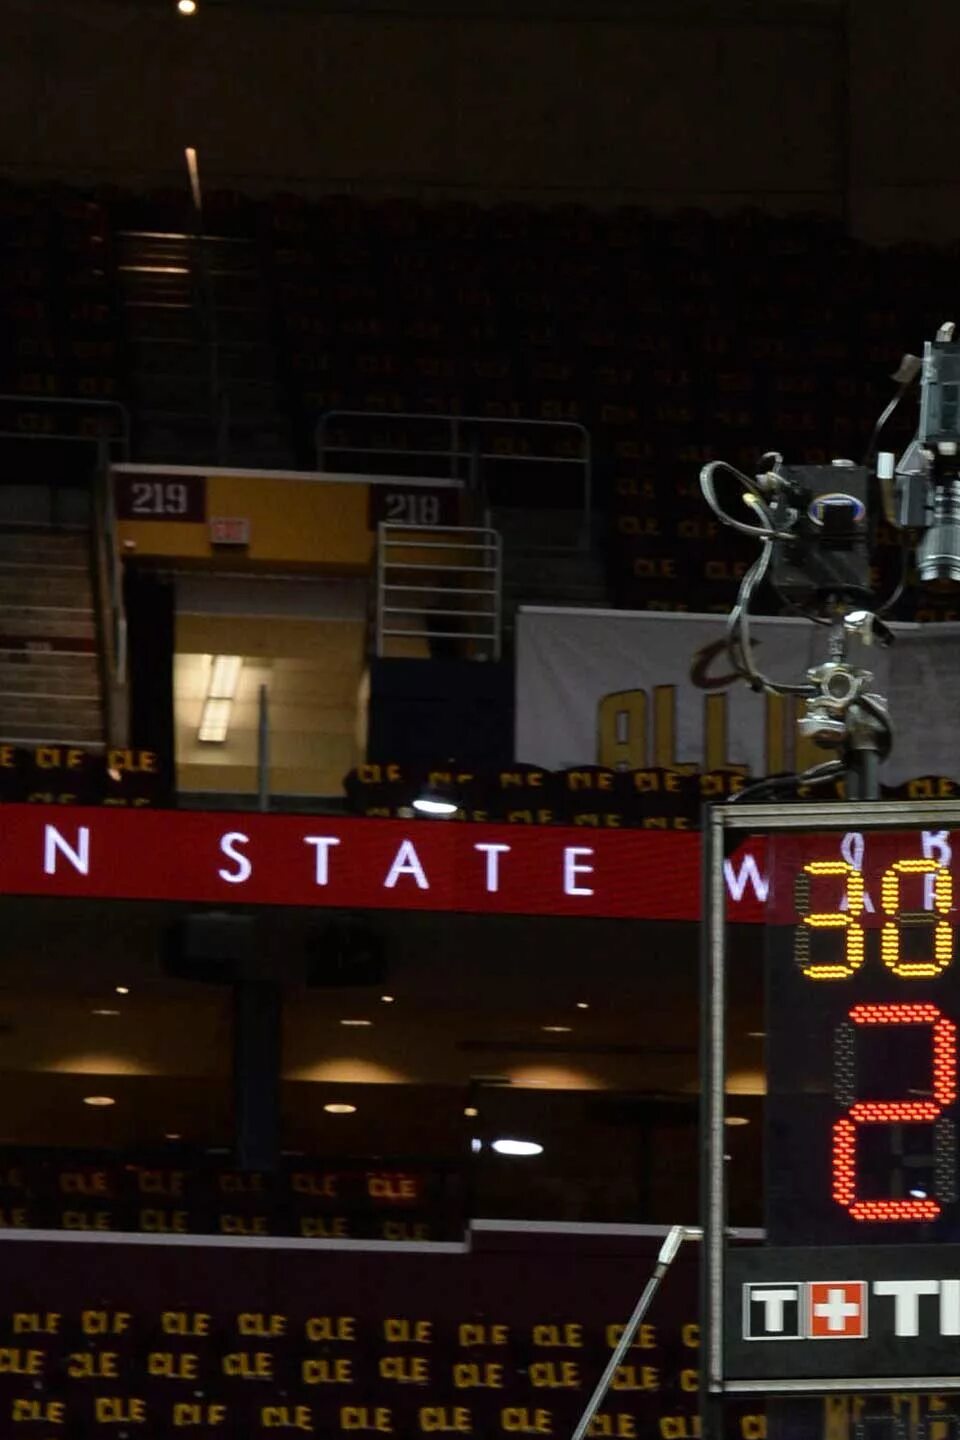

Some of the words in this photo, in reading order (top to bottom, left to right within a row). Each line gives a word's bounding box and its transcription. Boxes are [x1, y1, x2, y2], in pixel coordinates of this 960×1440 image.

[131, 483, 188, 515] 219
[385, 493, 440, 525] 218
[109, 749, 158, 773] CLE
[218, 831, 594, 896] STATE
[369, 1177, 417, 1198] CLE
[162, 1312, 210, 1335] CLE
[238, 1314, 286, 1335] CLE
[306, 1317, 353, 1340] CLE
[384, 1319, 430, 1342] CLE
[459, 1324, 507, 1345] CLE
[533, 1324, 583, 1347] CLE
[148, 1353, 197, 1379] CLE
[224, 1353, 271, 1376] CLE
[303, 1360, 349, 1384] CLE
[379, 1357, 427, 1381] CLE
[453, 1364, 502, 1387] CLE
[529, 1362, 578, 1386] CLE
[95, 1398, 144, 1422] CLE
[261, 1407, 312, 1430] CLE
[340, 1407, 392, 1432] CLE
[419, 1407, 471, 1431] CLE
[501, 1408, 551, 1432] CLE
